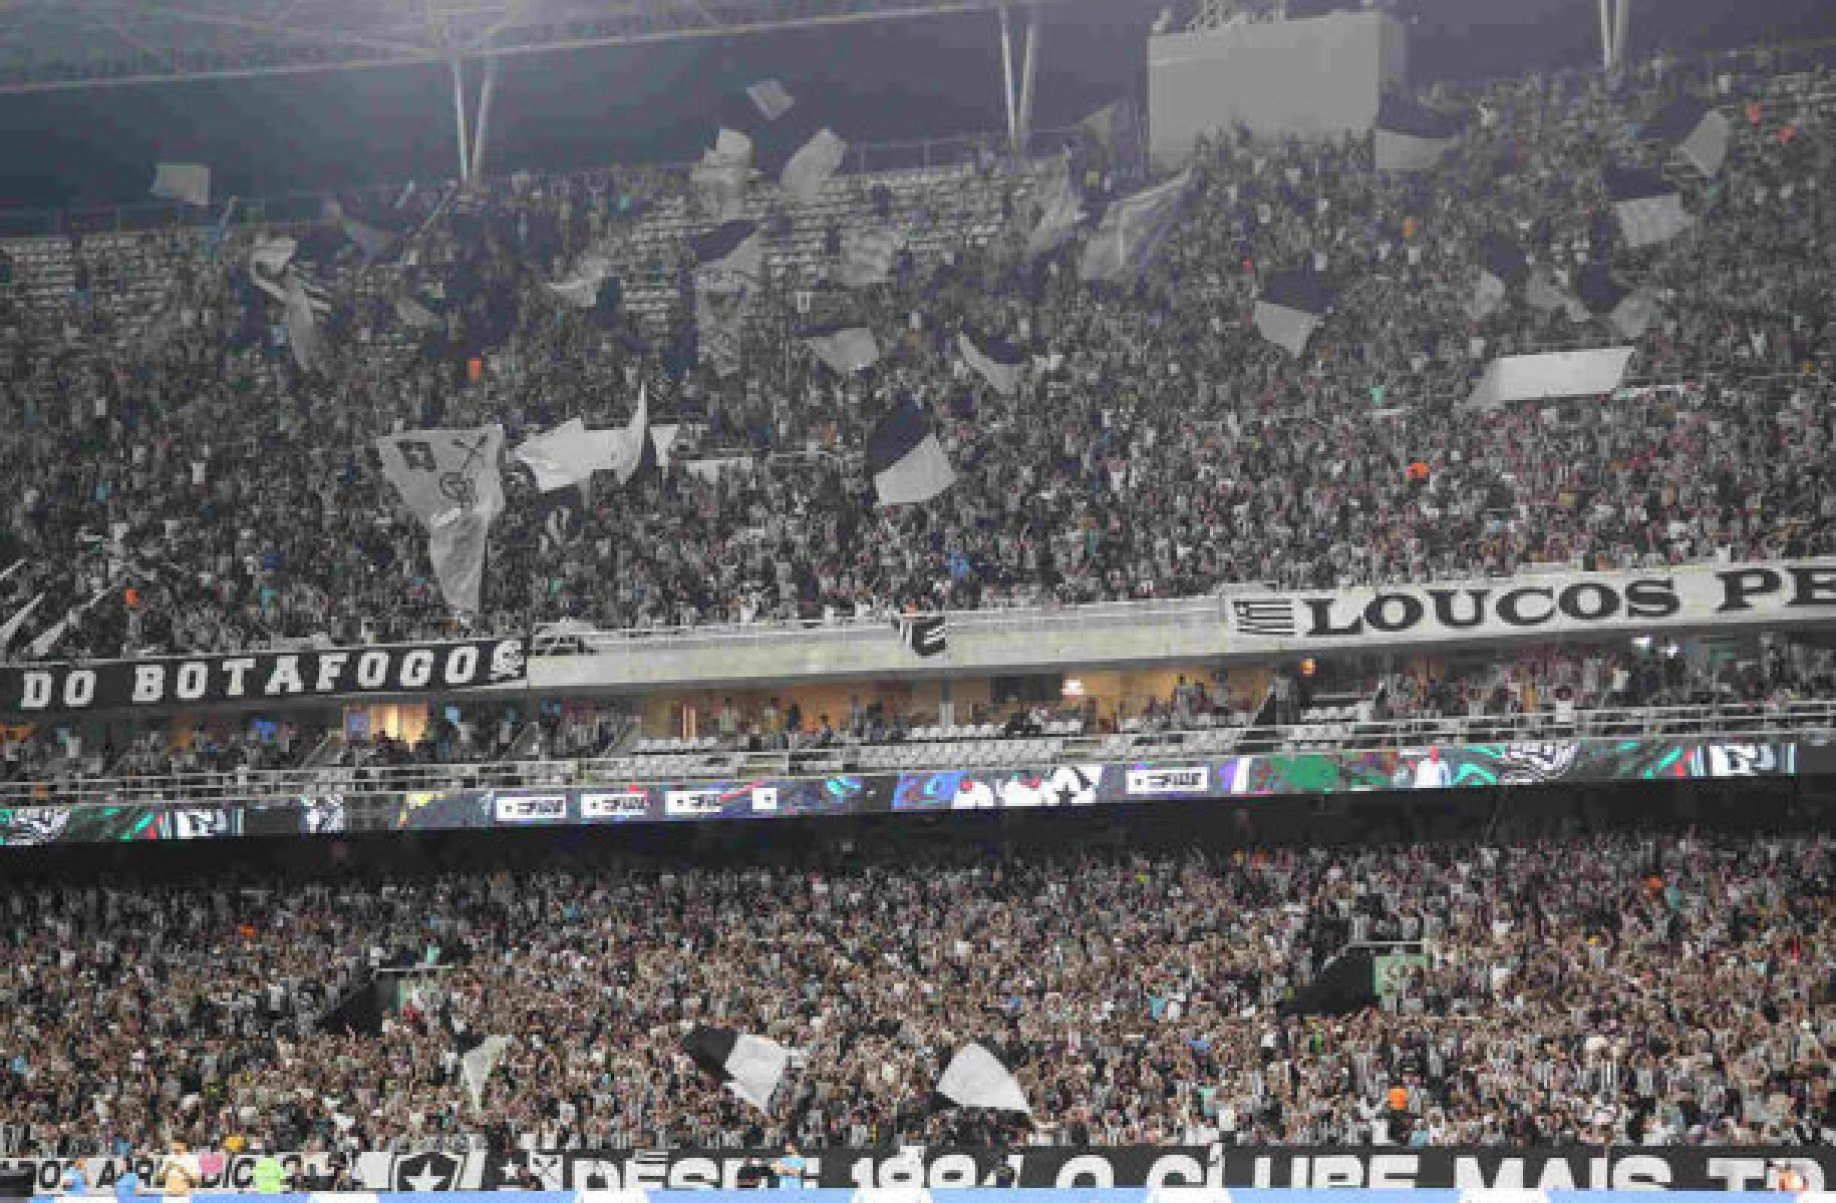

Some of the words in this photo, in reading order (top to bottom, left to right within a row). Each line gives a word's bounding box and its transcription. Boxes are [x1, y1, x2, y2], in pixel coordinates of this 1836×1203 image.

[1305, 578, 1680, 635] LOUCOS
[20, 669, 96, 710] DO
[131, 645, 480, 703] BOTAFOGO
